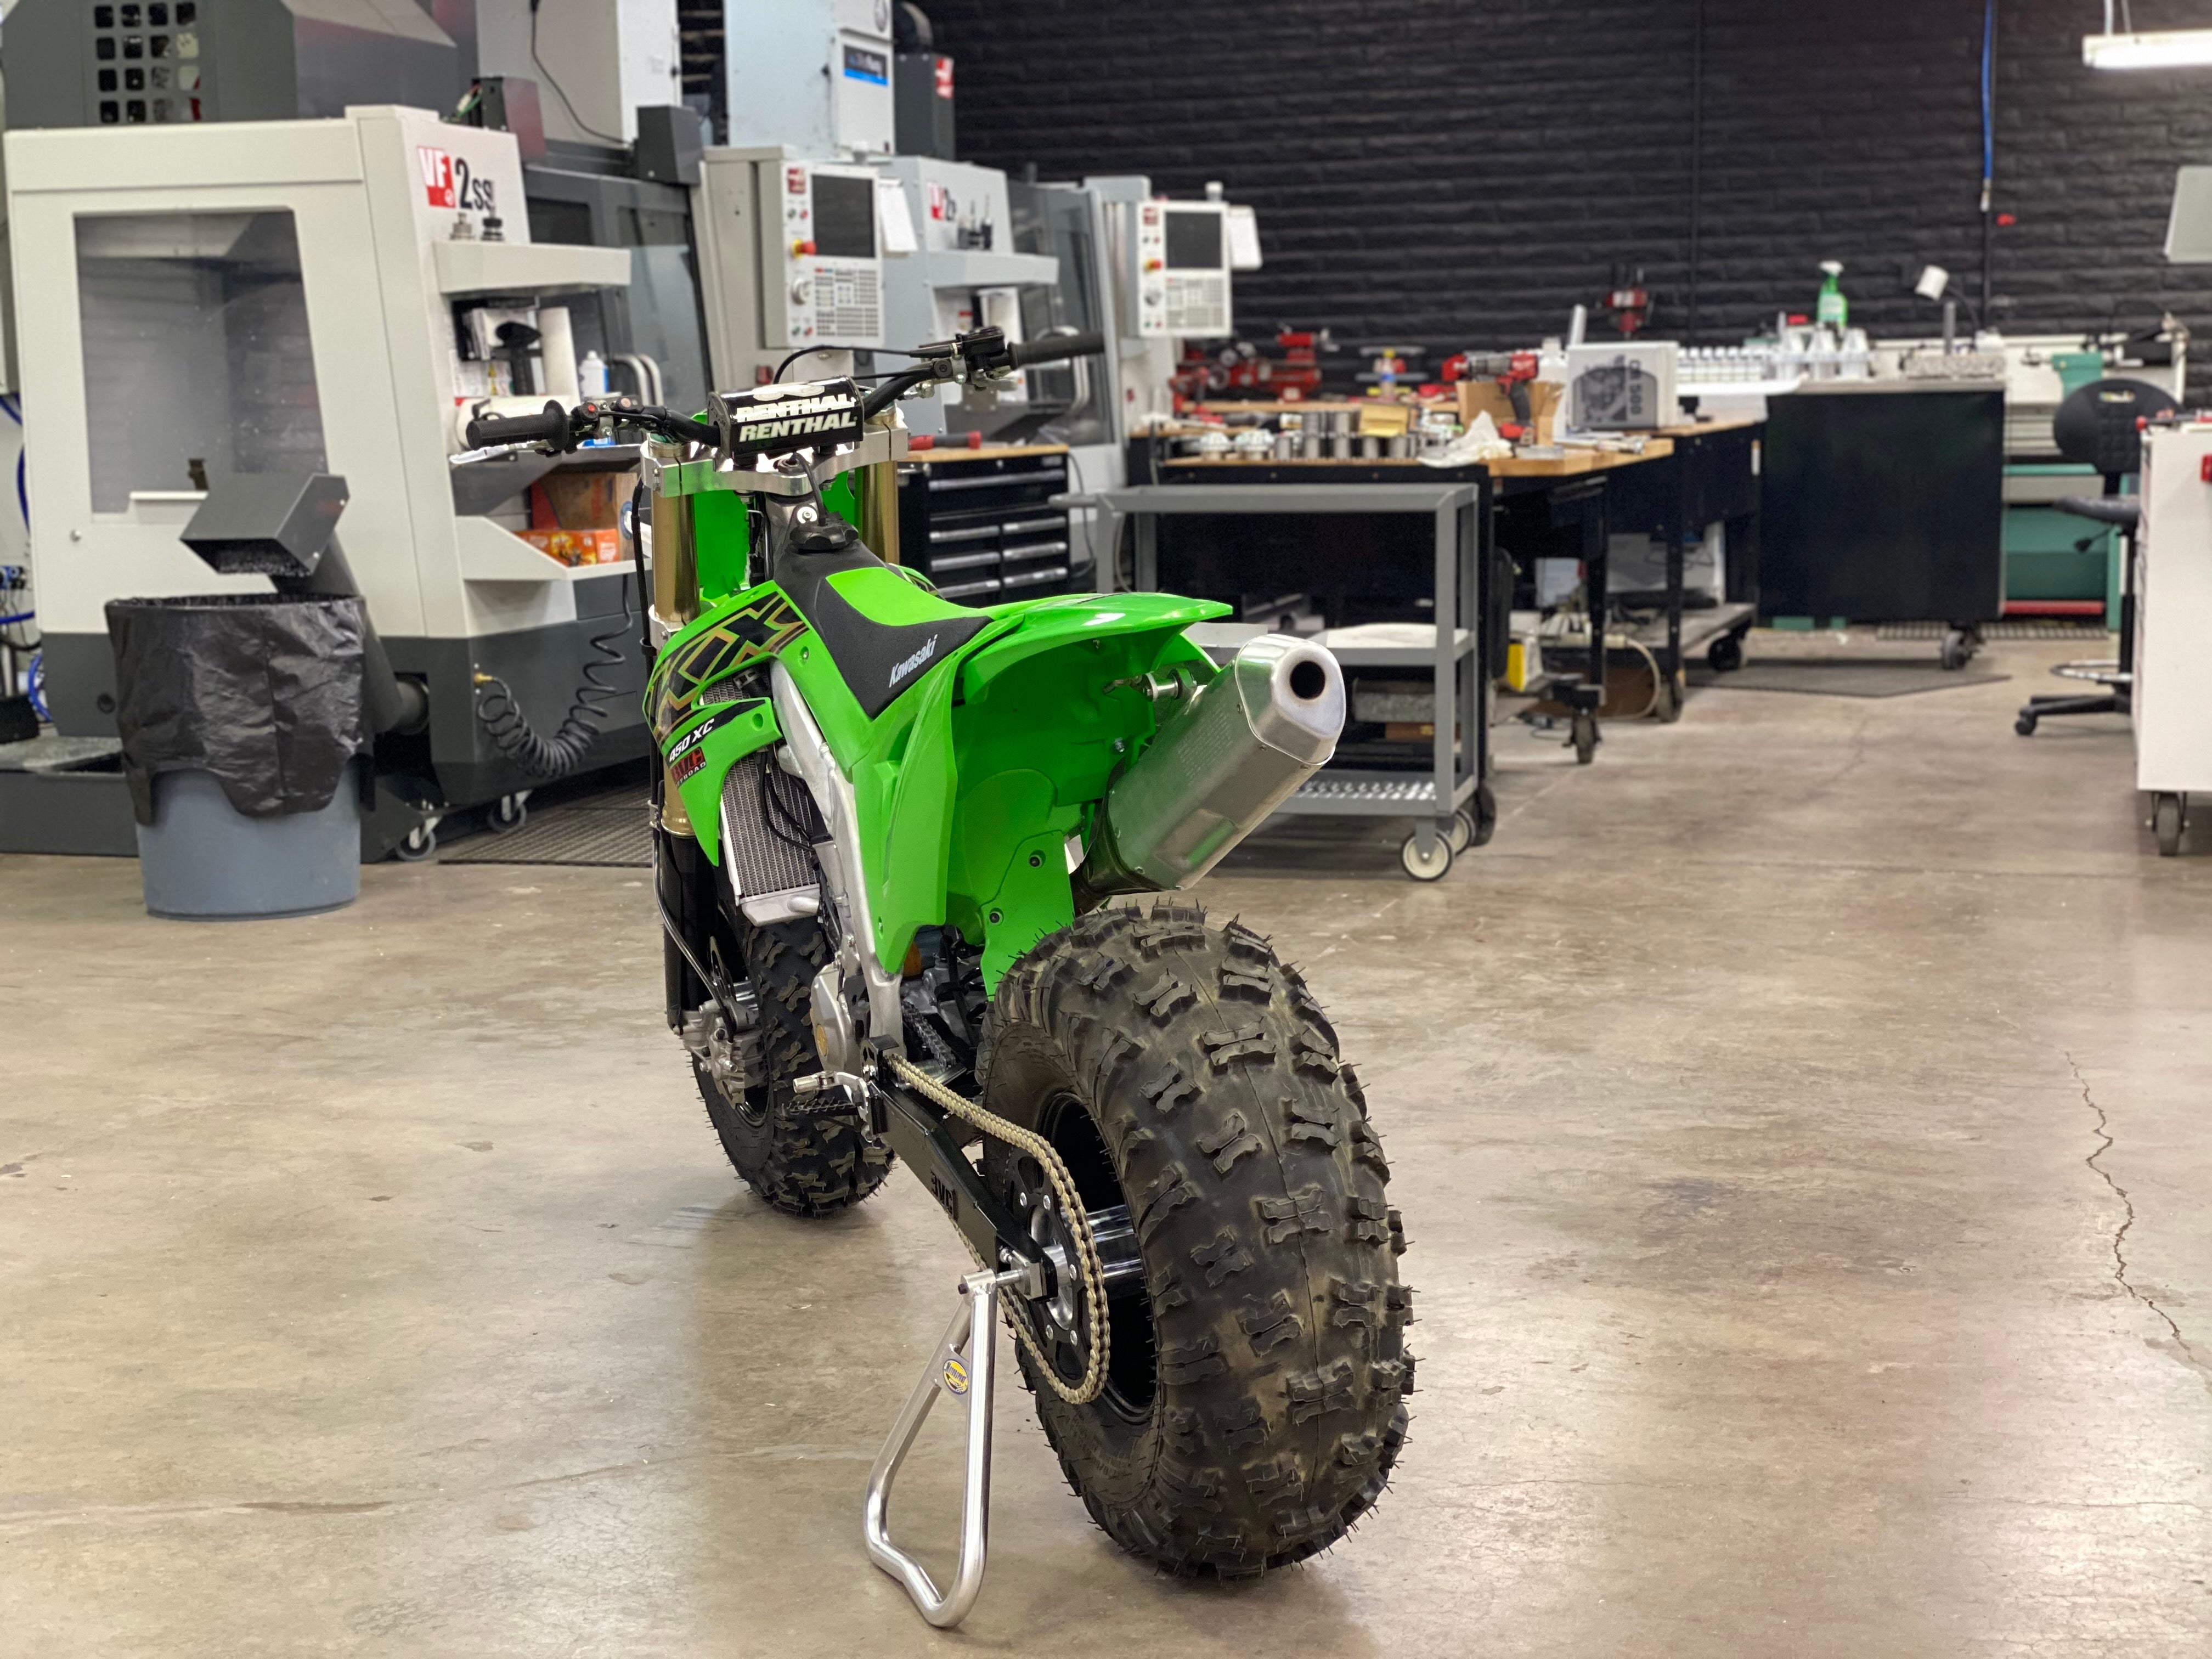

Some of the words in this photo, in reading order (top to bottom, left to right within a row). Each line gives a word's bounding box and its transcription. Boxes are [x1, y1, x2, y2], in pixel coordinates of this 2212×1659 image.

[739, 411, 858, 443] RENTHAL
[889, 634, 938, 688] Kawasaki
[669, 734, 691, 763] 450
[691, 718, 715, 743] XC
